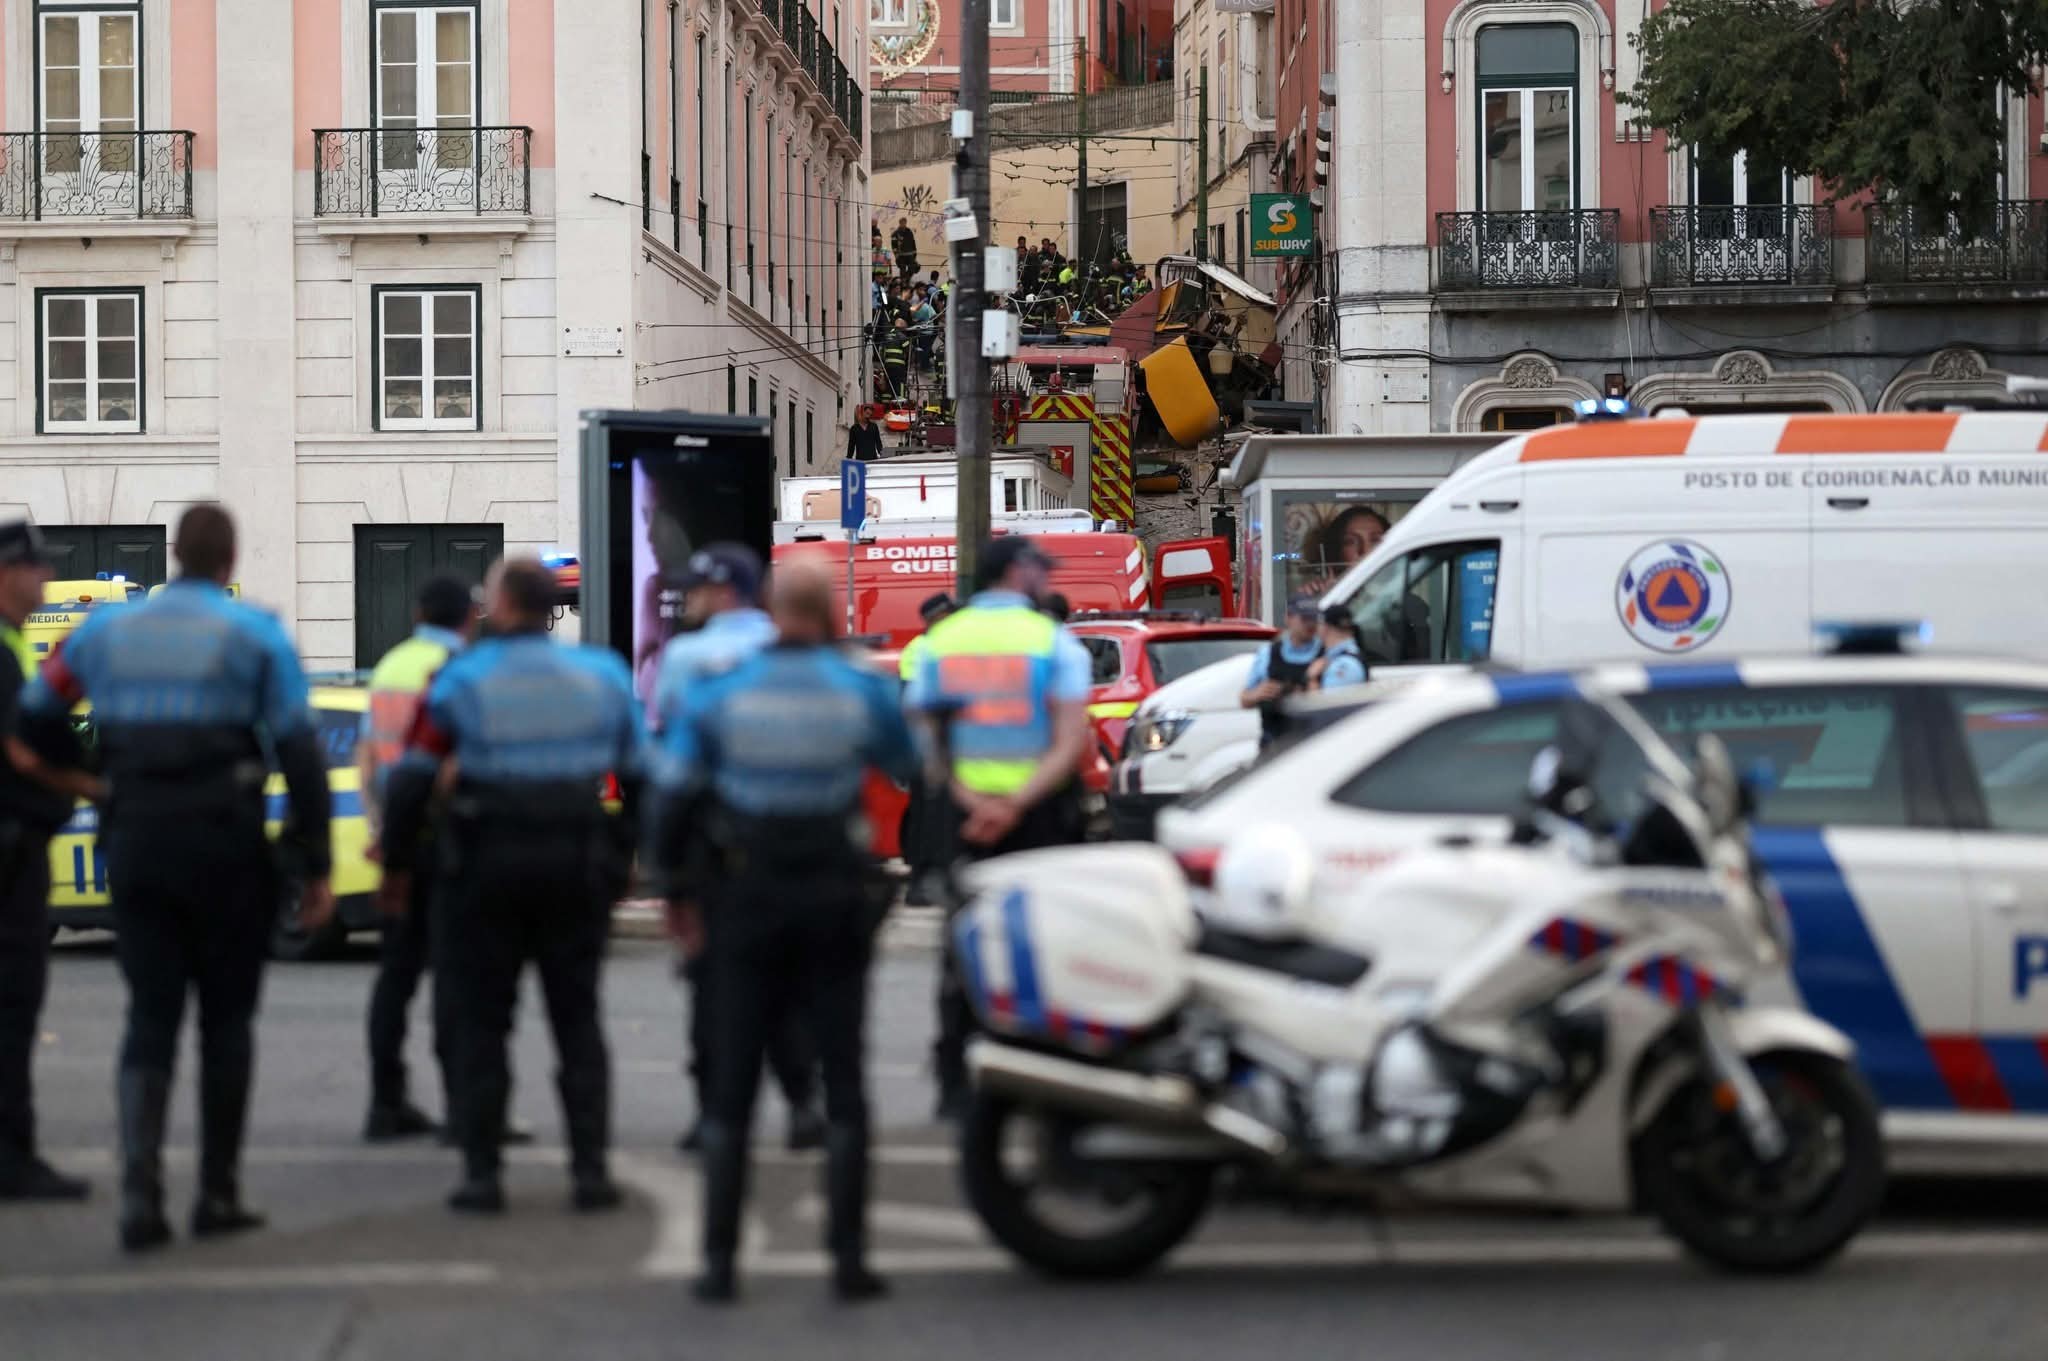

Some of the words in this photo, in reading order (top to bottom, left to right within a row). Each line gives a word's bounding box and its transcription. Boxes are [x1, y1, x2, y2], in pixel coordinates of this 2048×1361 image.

[1256, 239, 1311, 250] SUBWAY
[1684, 471, 1758, 487] POSTO
[1765, 471, 1793, 487] DE
[1802, 464, 1970, 488] COORDENAÇÃO
[847, 465, 860, 510] P
[28, 613, 71, 624] MÉDICA
